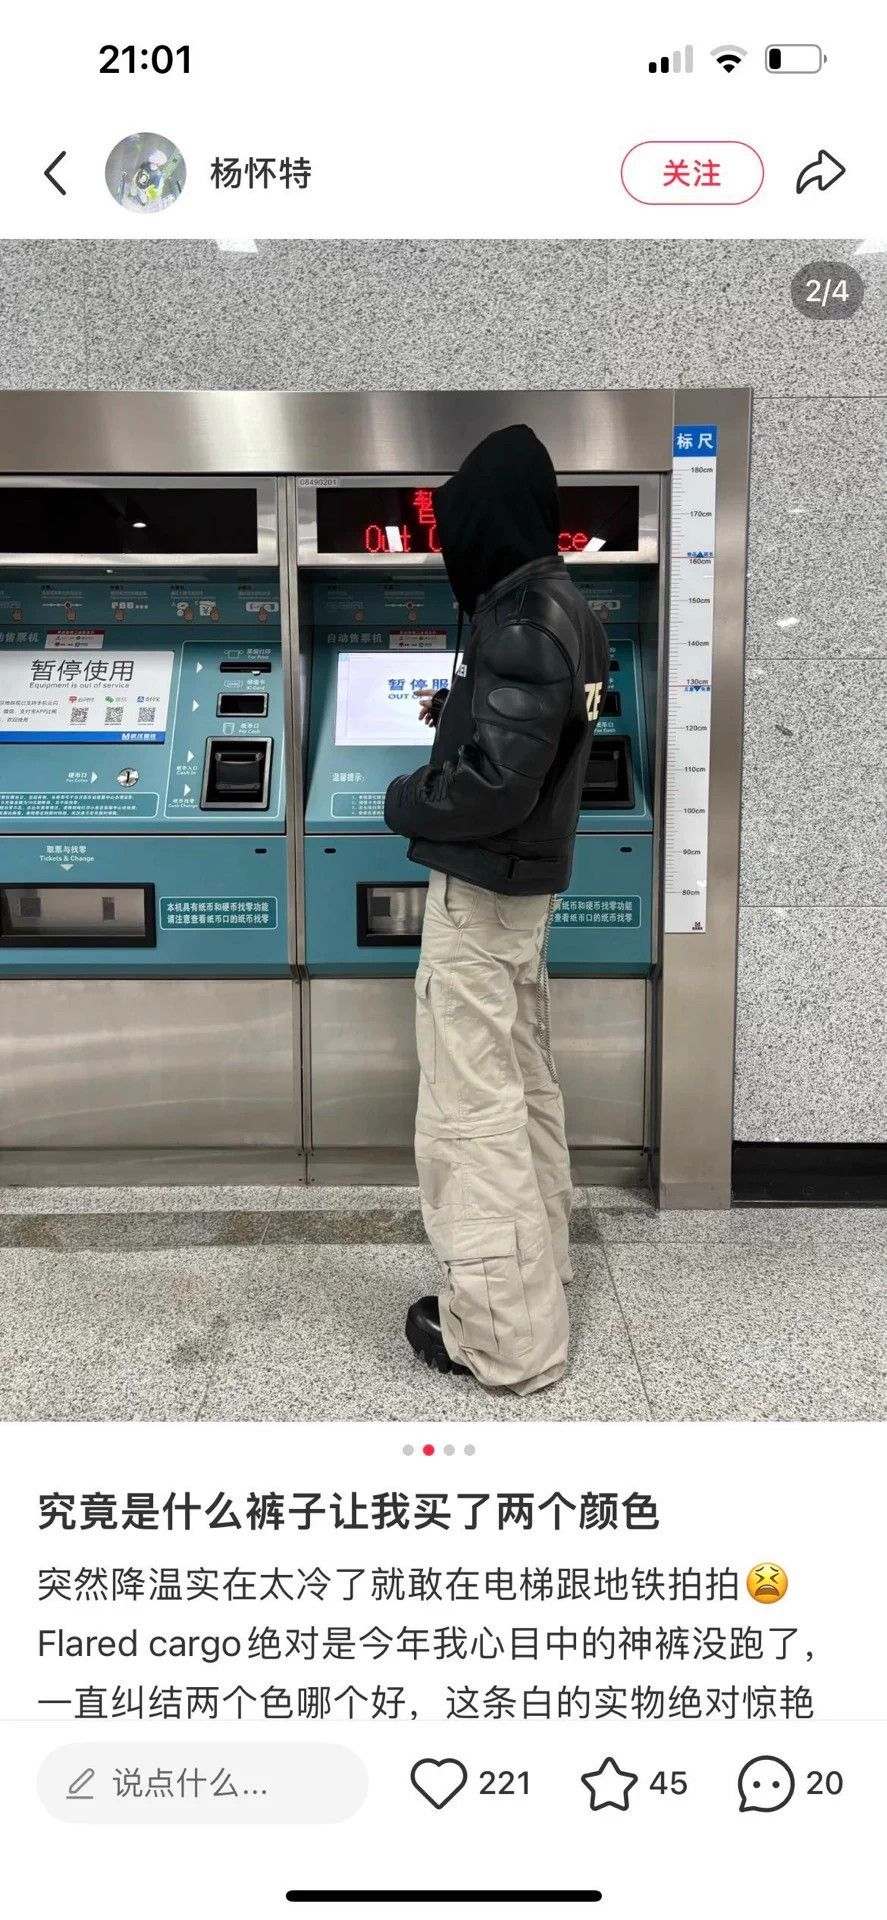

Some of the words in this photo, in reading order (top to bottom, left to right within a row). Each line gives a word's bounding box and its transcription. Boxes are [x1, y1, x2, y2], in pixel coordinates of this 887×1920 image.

[676, 433, 714, 449] 标尺
[30, 659, 135, 682] 暂停使用
[29, 682, 70, 690] Equipment
[70, 855, 95, 863] Change
[167, 902, 269, 912] 本机具有纸币和硬币找零功能
[167, 914, 269, 924] 请注意查看纸币口的纸币找零
